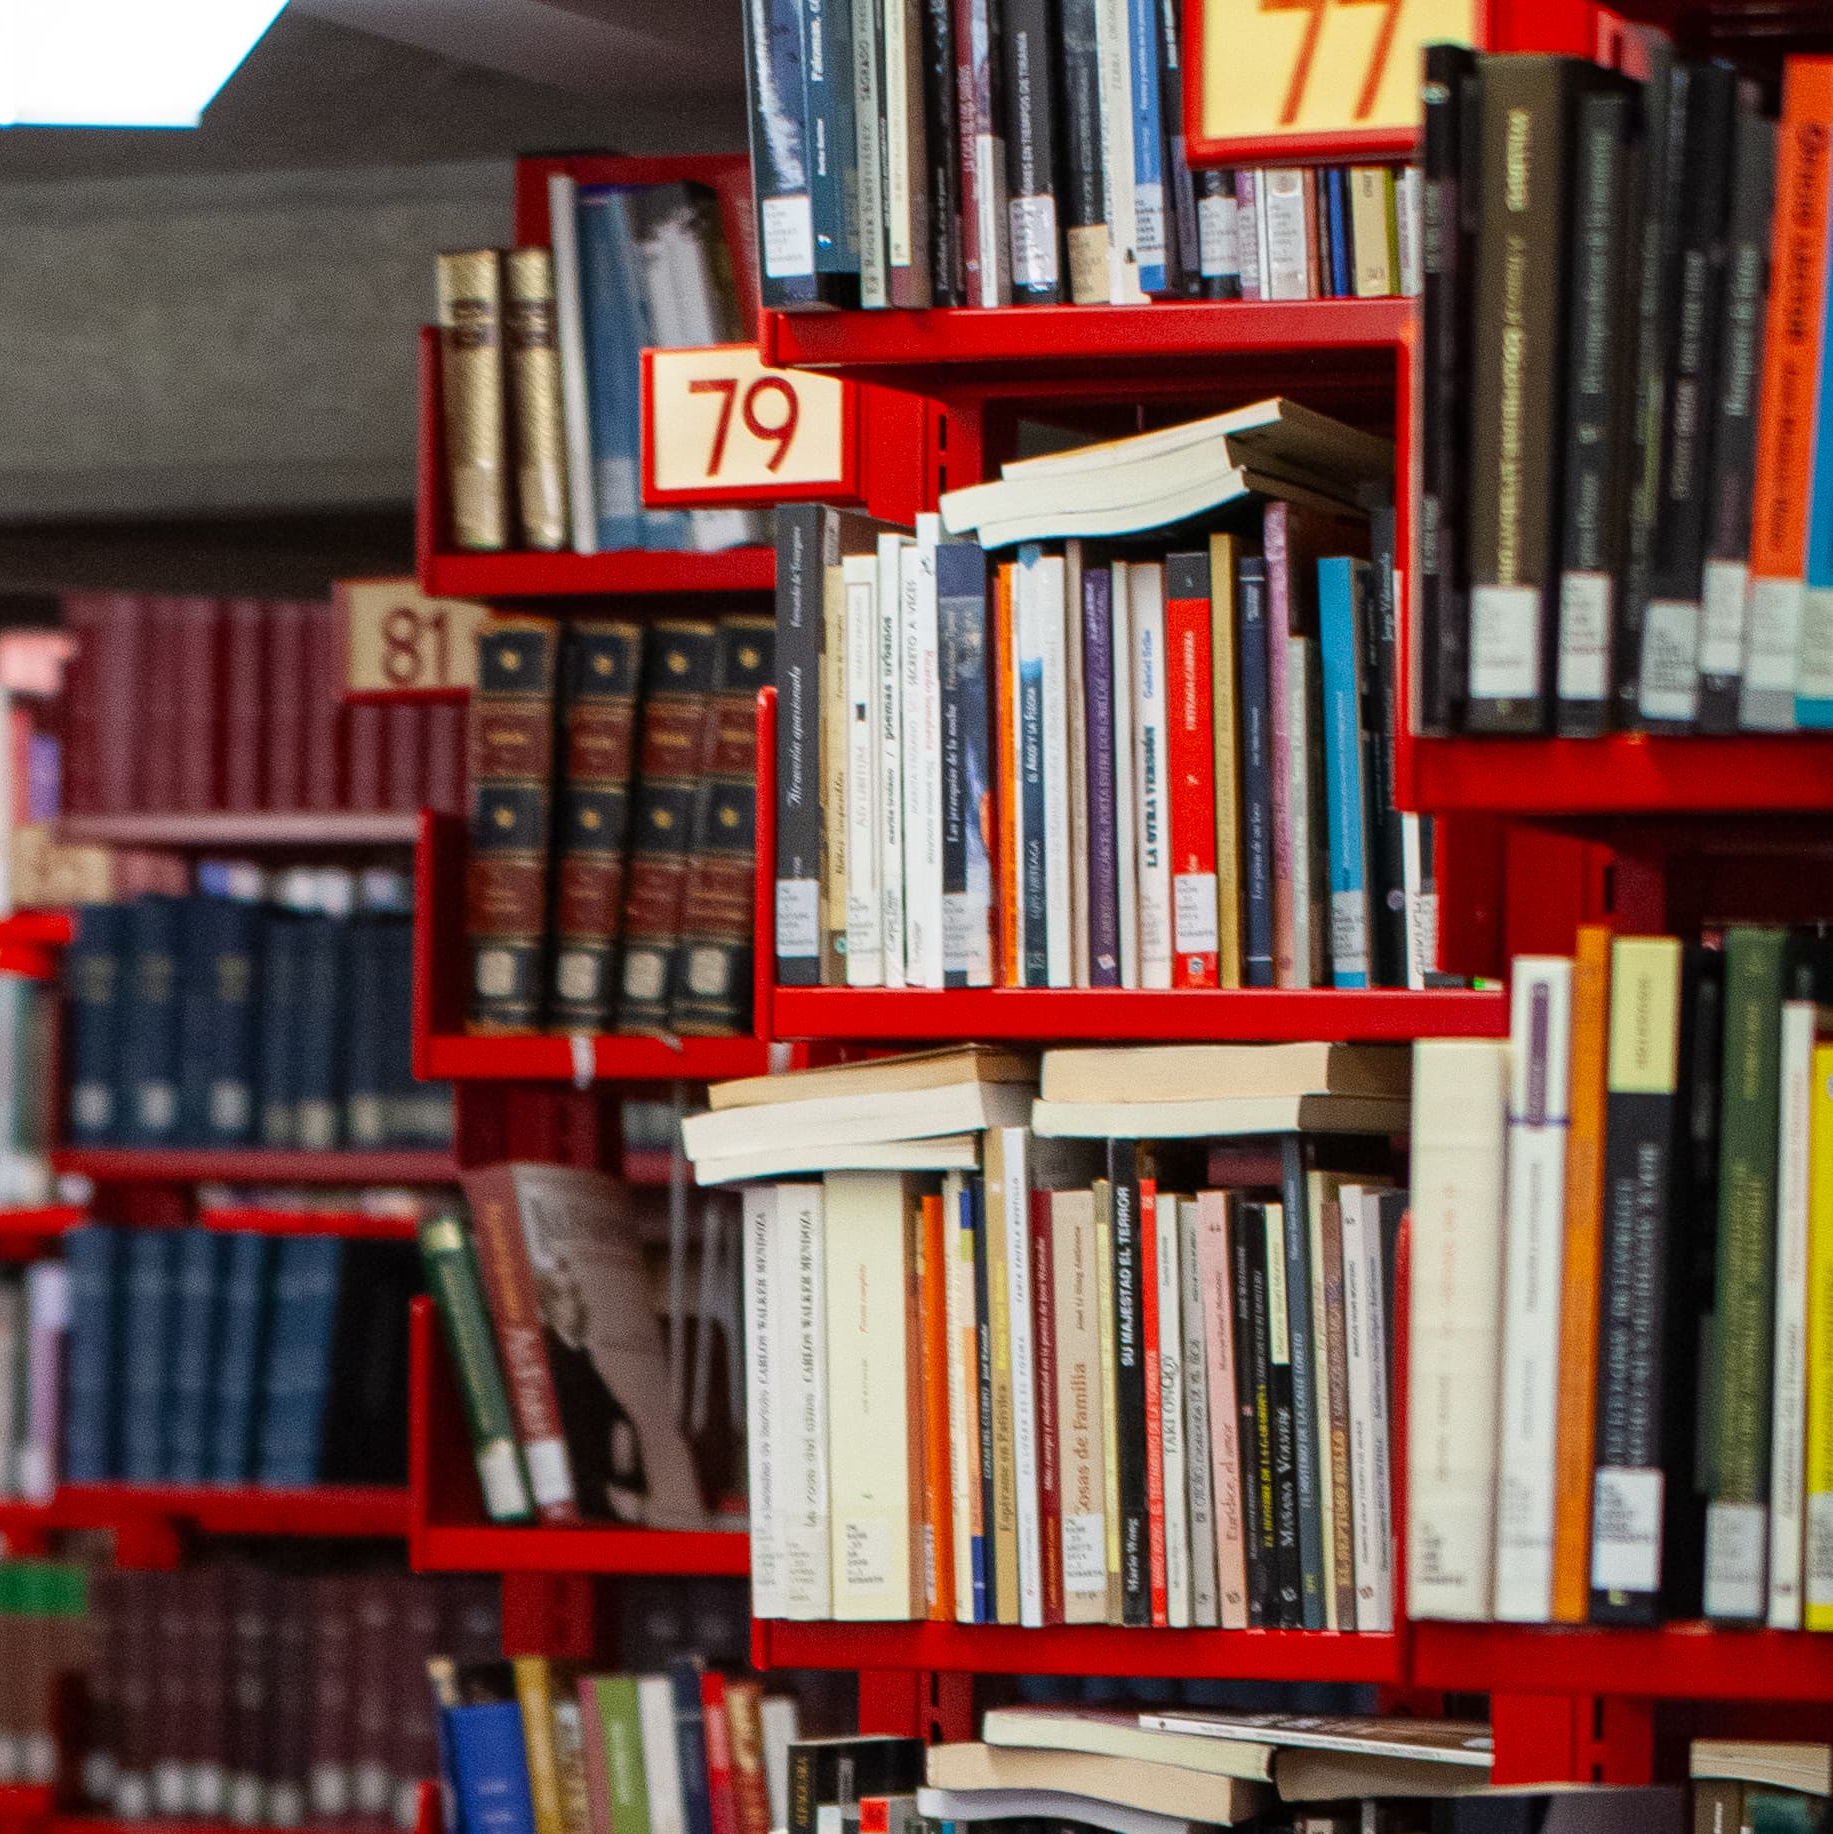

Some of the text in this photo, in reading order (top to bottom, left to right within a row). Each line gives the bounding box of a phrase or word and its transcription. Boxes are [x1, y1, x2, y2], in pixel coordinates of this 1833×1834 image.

[1258, 0, 1401, 126] 77
[689, 375, 801, 477] 79
[381, 608, 450, 686] 81
[786, 666, 804, 807] Atracción apasionada
[882, 684, 897, 740] poemas
[1145, 848, 1159, 868] LA
[755, 1212, 768, 1273] MENDOZA
[799, 1210, 812, 1271] MENDOZA
[756, 1278, 769, 1330] WALKER
[800, 1276, 813, 1329] WALKER
[1118, 1187, 1135, 1366] SU MAJESTAD EL TERROR
[756, 1335, 770, 1385] CARLOS
[801, 1334, 814, 1383] CARLOS
[1071, 1363, 1090, 1431] Familia
[1072, 1436, 1091, 1459] de
